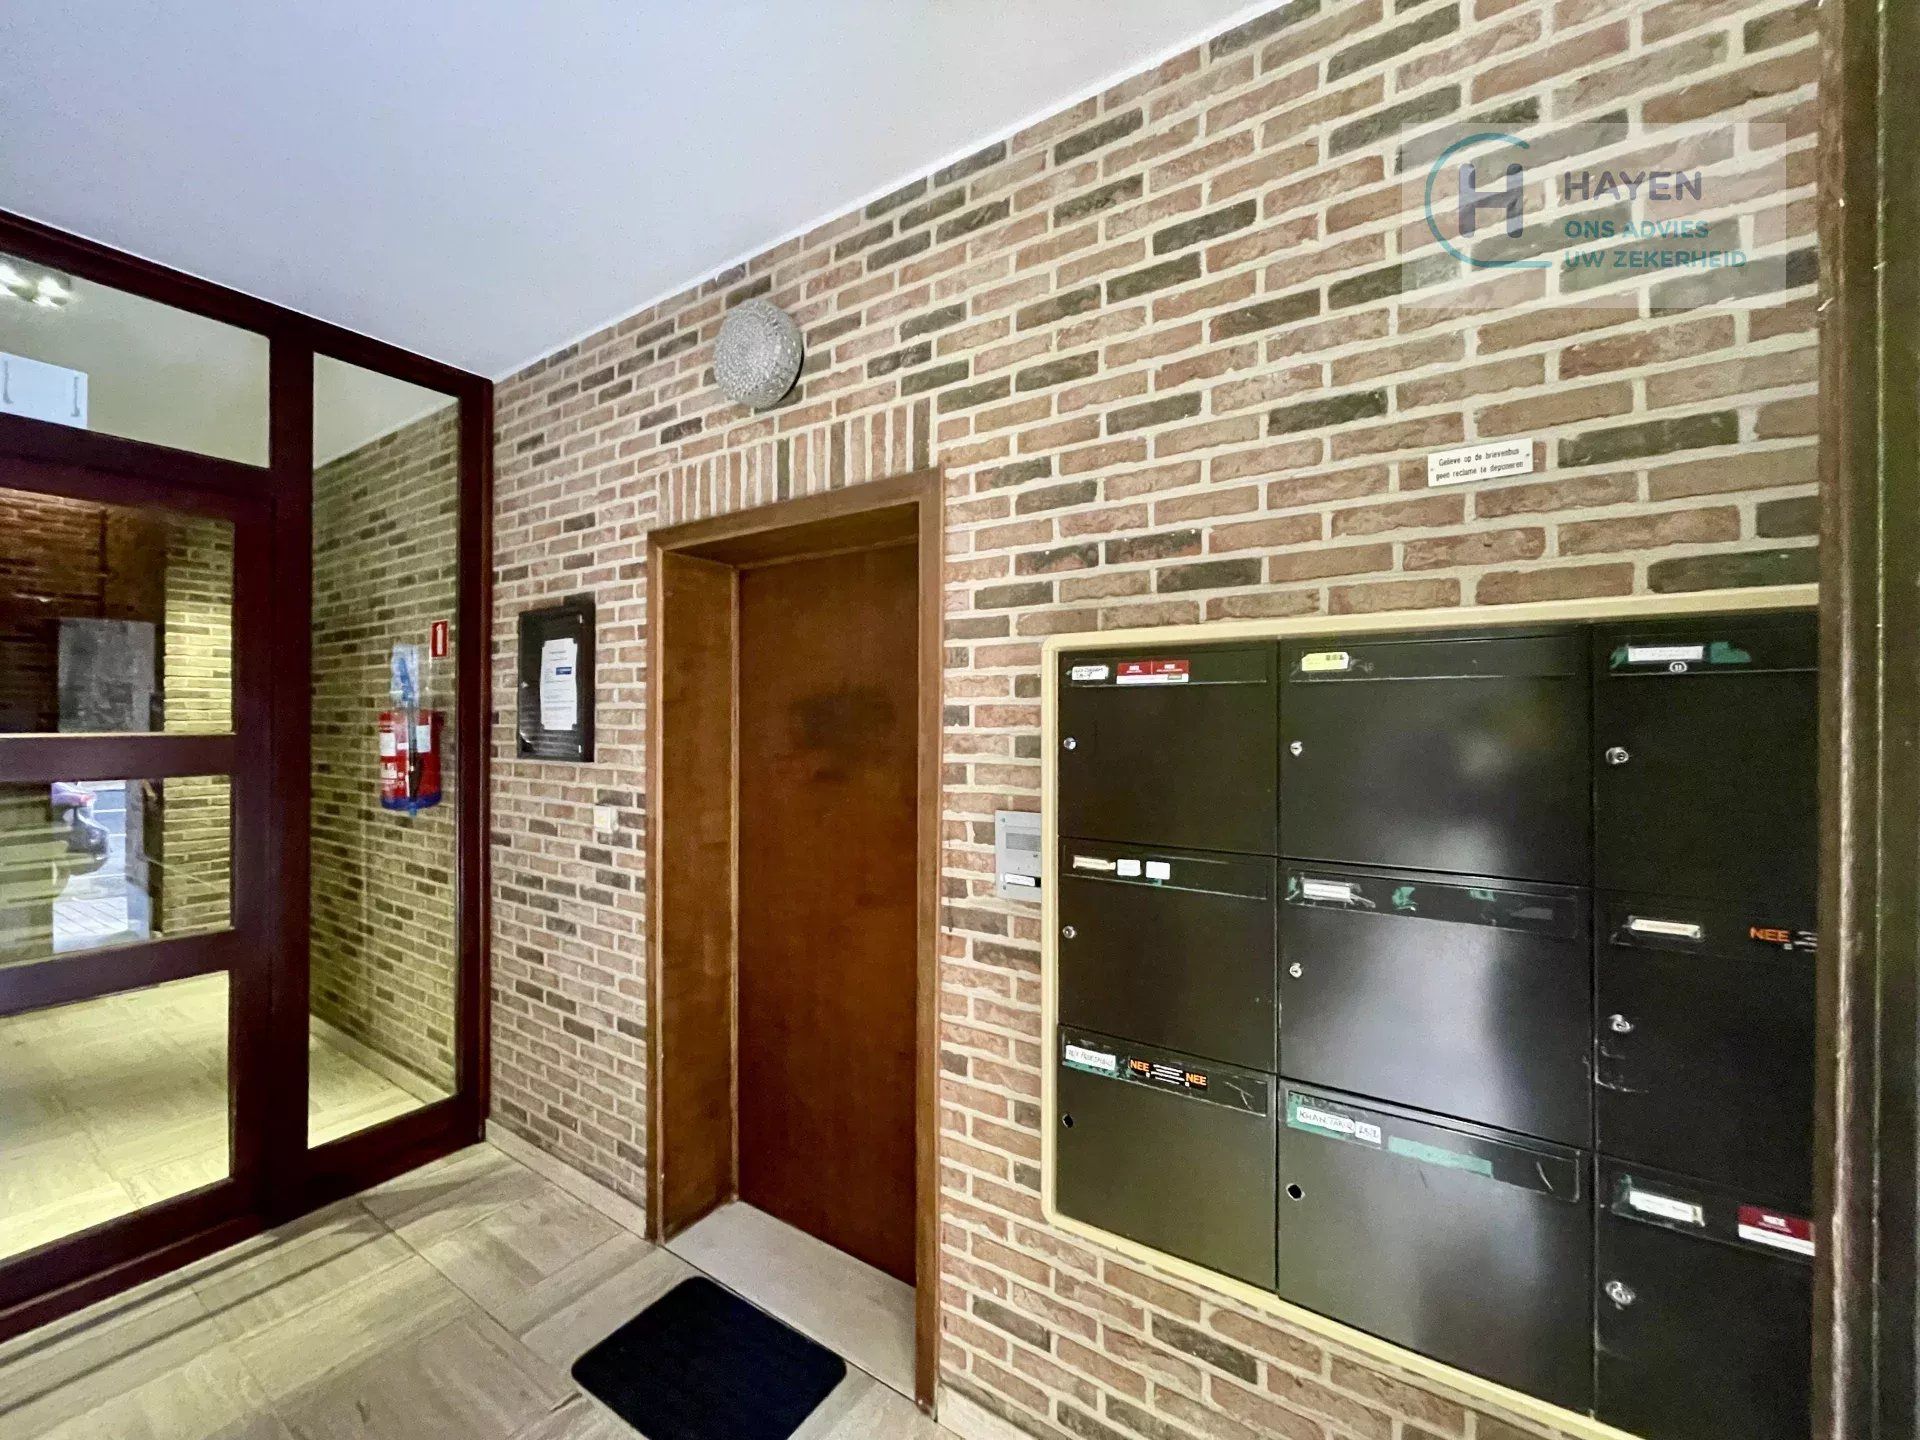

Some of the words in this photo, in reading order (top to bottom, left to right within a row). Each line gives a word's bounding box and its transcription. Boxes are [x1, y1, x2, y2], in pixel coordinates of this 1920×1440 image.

[1463, 455, 1472, 463] op
[1435, 471, 1451, 481] geen
[1452, 467, 1477, 477] reclame
[1479, 465, 1487, 473] te
[1750, 926, 1790, 943] NEE
[1130, 1059, 1150, 1073] NEE
[1185, 1072, 1207, 1086] NEE
